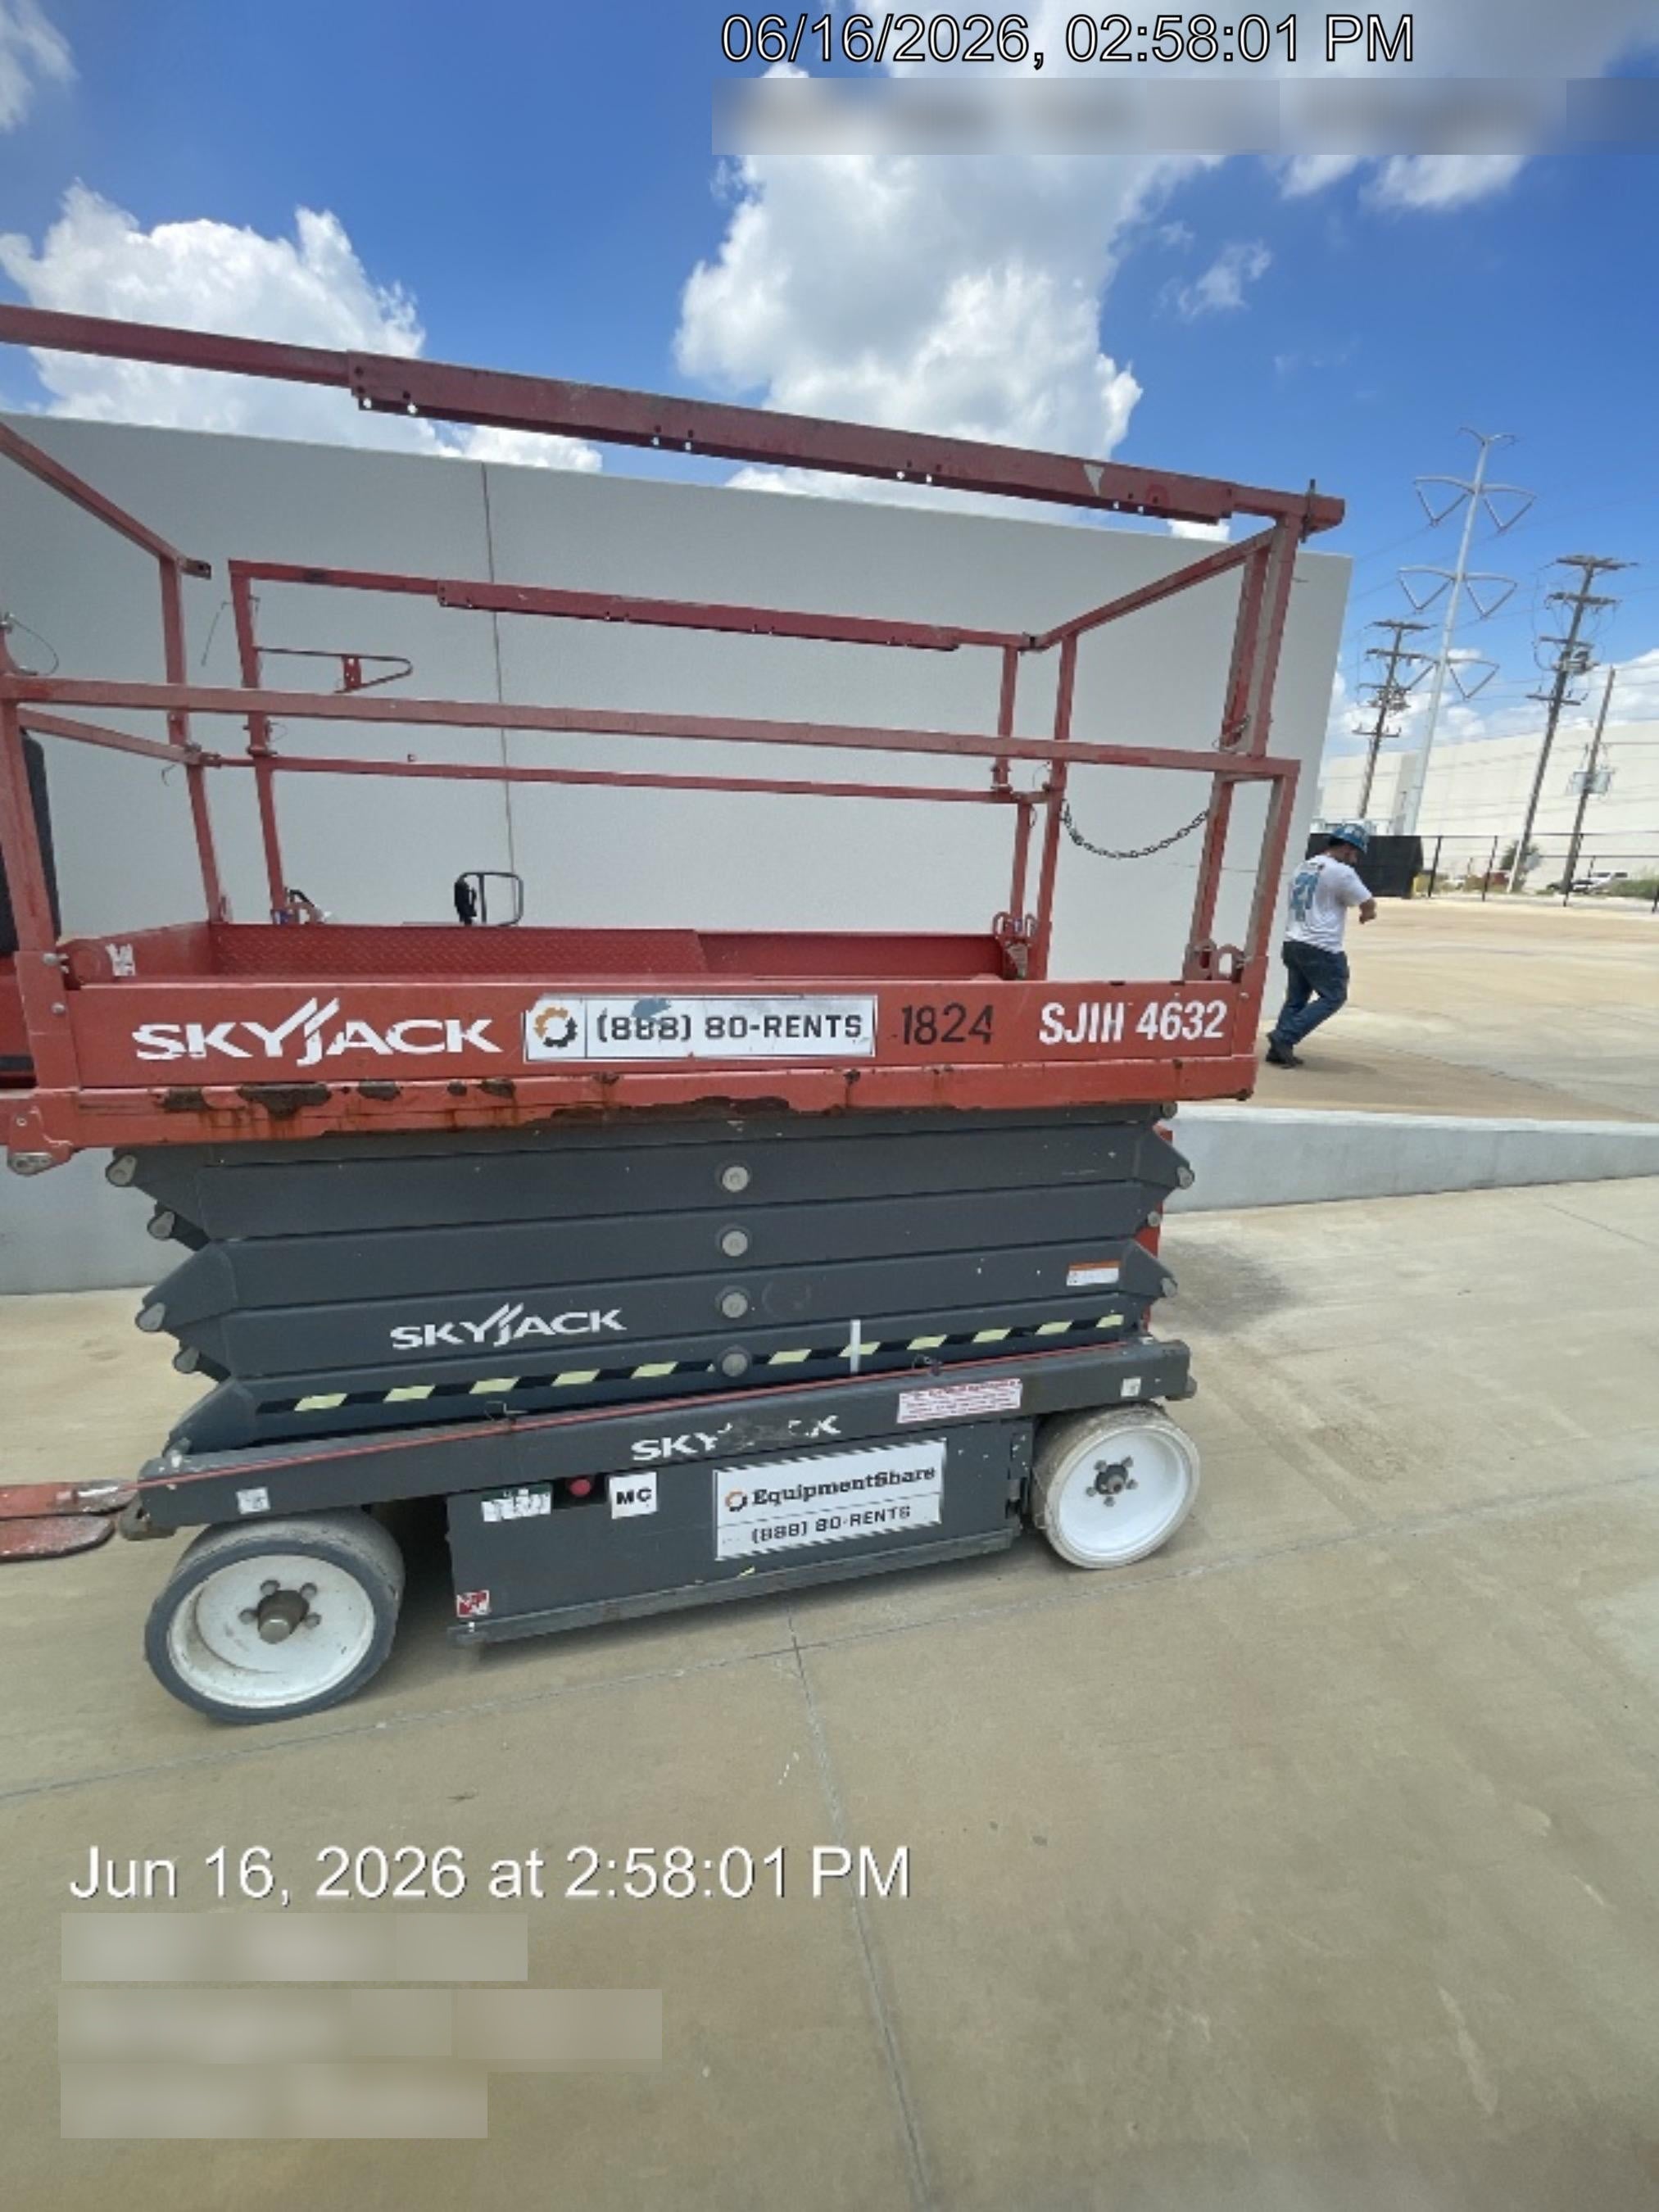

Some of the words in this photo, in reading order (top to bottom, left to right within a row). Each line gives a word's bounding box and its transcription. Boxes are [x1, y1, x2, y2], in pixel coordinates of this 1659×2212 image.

[132, 997, 502, 1067] SKYJACK
[597, 1008, 691, 1042] (888)
[705, 1015, 862, 1040] 80-RENTS
[902, 1003, 993, 1045] 1824
[1135, 999, 1227, 1040] 4632
[390, 1303, 627, 1350] SKYJACK
[751, 1467, 936, 1505] EquipmentShare
[752, 1521, 806, 1543] (888)
[815, 1506, 911, 1532] 80-RENTS
